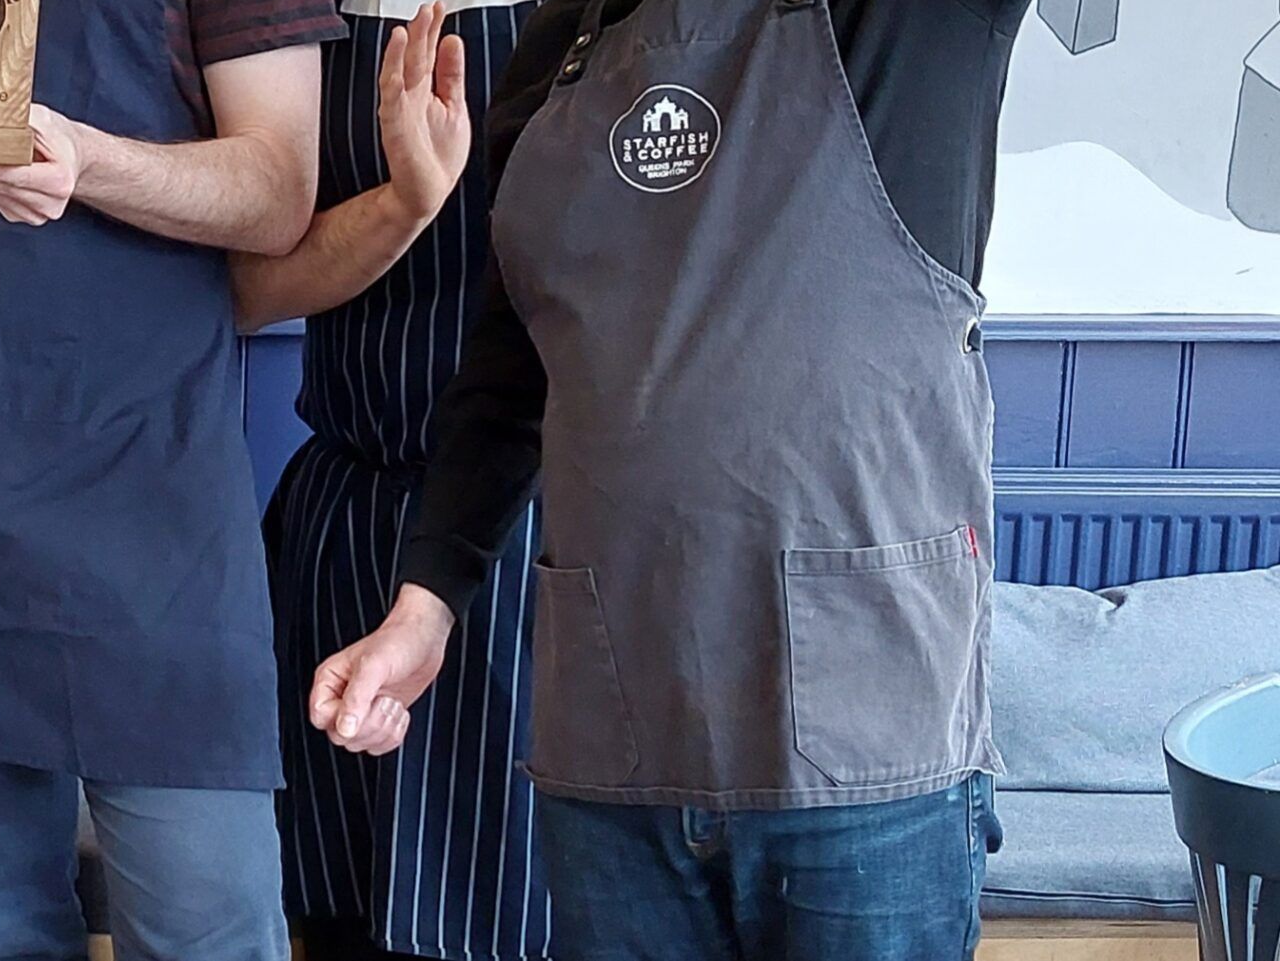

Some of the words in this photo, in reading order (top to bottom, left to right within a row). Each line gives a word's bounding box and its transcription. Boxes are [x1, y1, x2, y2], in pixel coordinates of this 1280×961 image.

[623, 131, 708, 151] STARFISH
[623, 151, 632, 162] &
[638, 143, 708, 160] COFFEE
[673, 159, 695, 168] PARK
[647, 167, 687, 179] BRIGHTON
